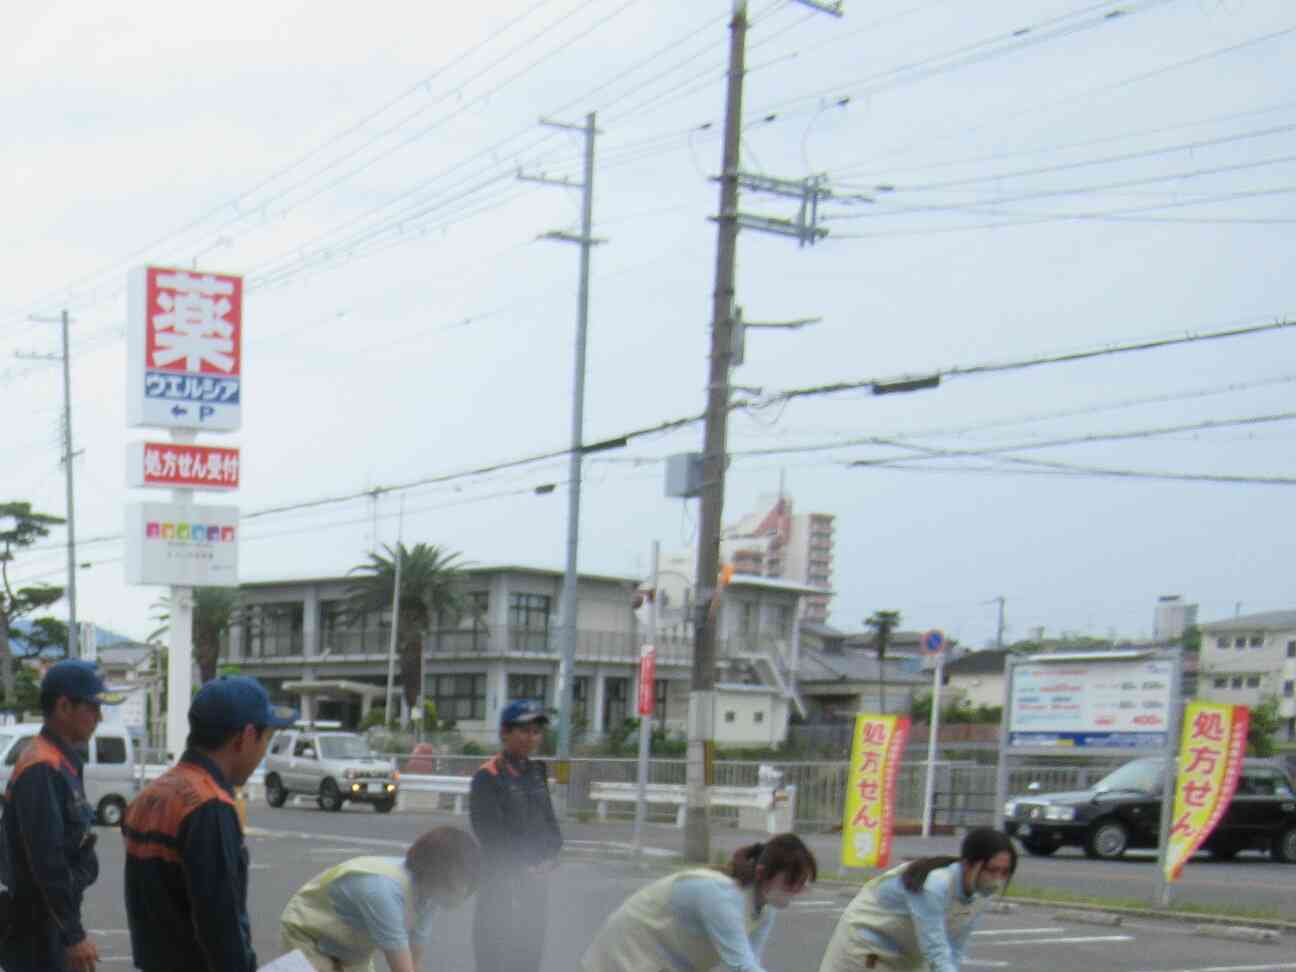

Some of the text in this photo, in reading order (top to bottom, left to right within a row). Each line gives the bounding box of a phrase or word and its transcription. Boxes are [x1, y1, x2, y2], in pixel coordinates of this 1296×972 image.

[152, 270, 235, 373] 薬
[145, 374, 239, 404] ウエルシア
[200, 406, 216, 423] P
[854, 723, 885, 828] 処方せん
[1170, 712, 1222, 835] 処方せん
